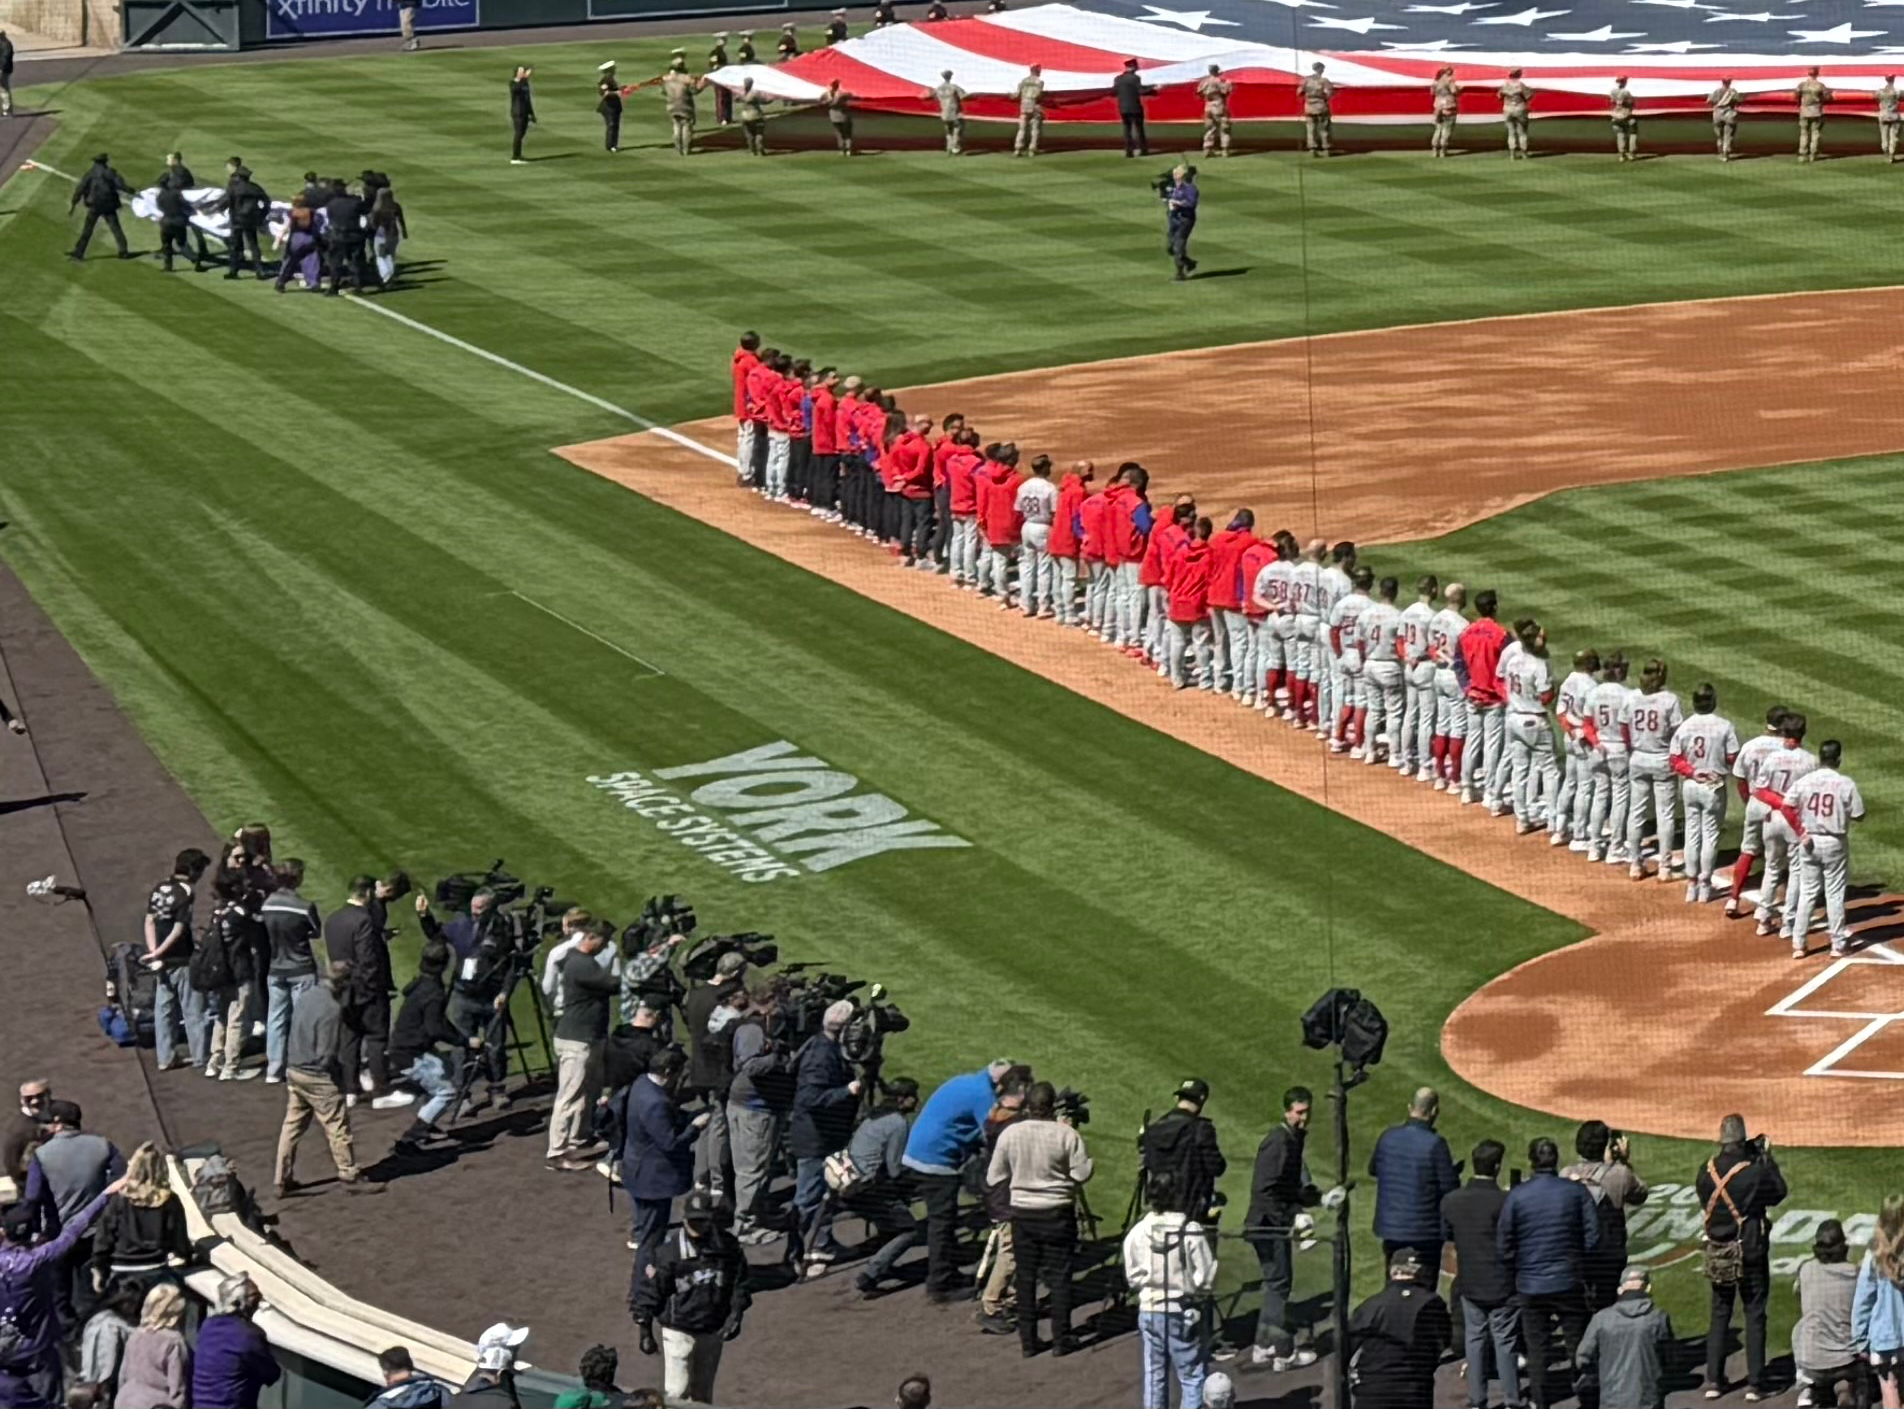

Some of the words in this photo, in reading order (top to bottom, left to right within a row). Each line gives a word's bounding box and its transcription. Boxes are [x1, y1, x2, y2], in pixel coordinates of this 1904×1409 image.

[1633, 708, 1660, 732] 28
[586, 771, 696, 829] SPACE
[670, 815, 801, 883] SYSTEMS
[652, 739, 975, 873] YORK
[1807, 792, 1835, 818] 49
